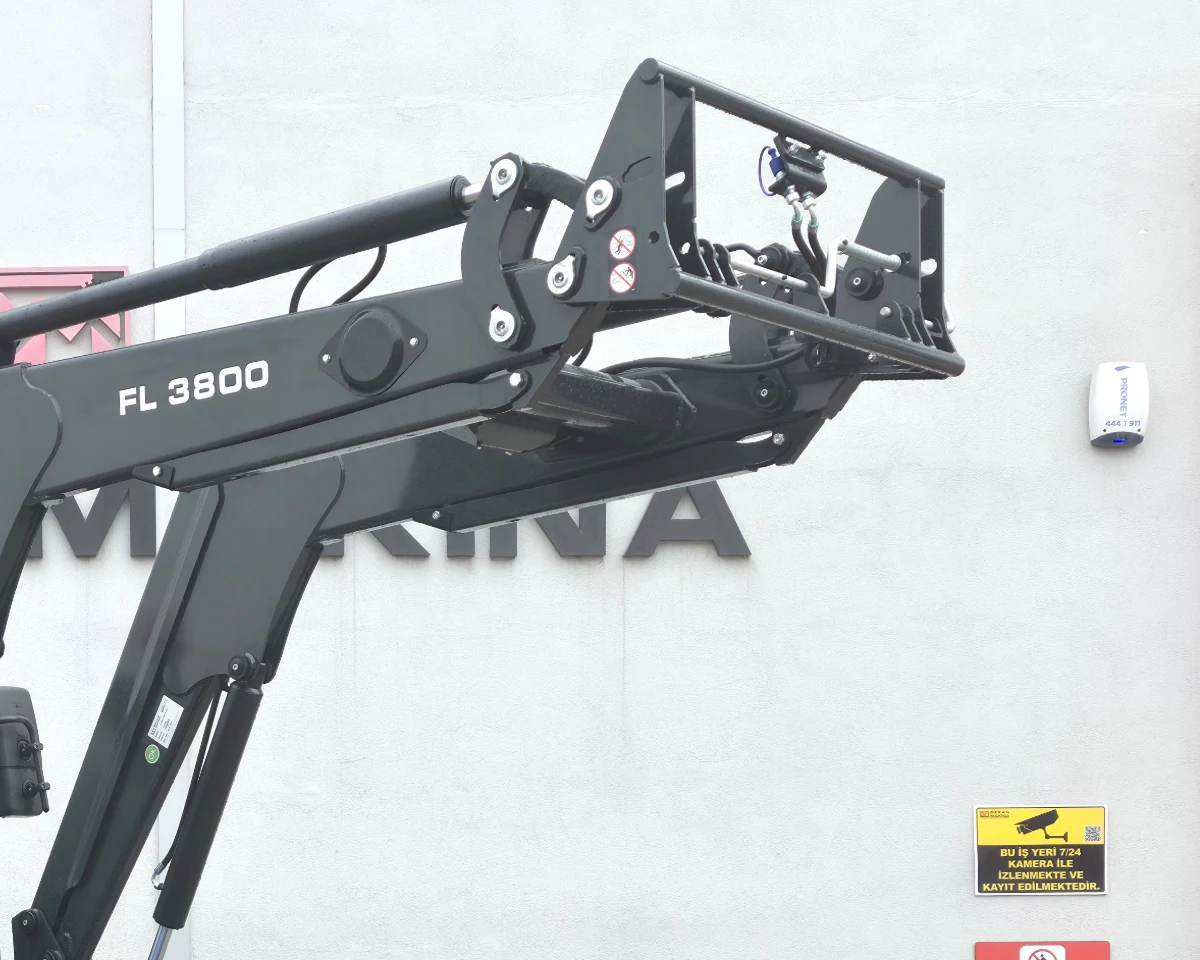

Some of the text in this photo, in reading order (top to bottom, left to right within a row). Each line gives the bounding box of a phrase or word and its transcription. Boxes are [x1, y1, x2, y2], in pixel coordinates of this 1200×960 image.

[119, 359, 269, 416] FL 3800
[1000, 846, 1081, 859] BU İŞ YERİ 7/24
[1008, 858, 1074, 868] KAMERA İLE
[998, 870, 1084, 880] İZLENMEKTE VE
[982, 881, 1101, 892] KAYIT EDİLMEKTEDİR.
